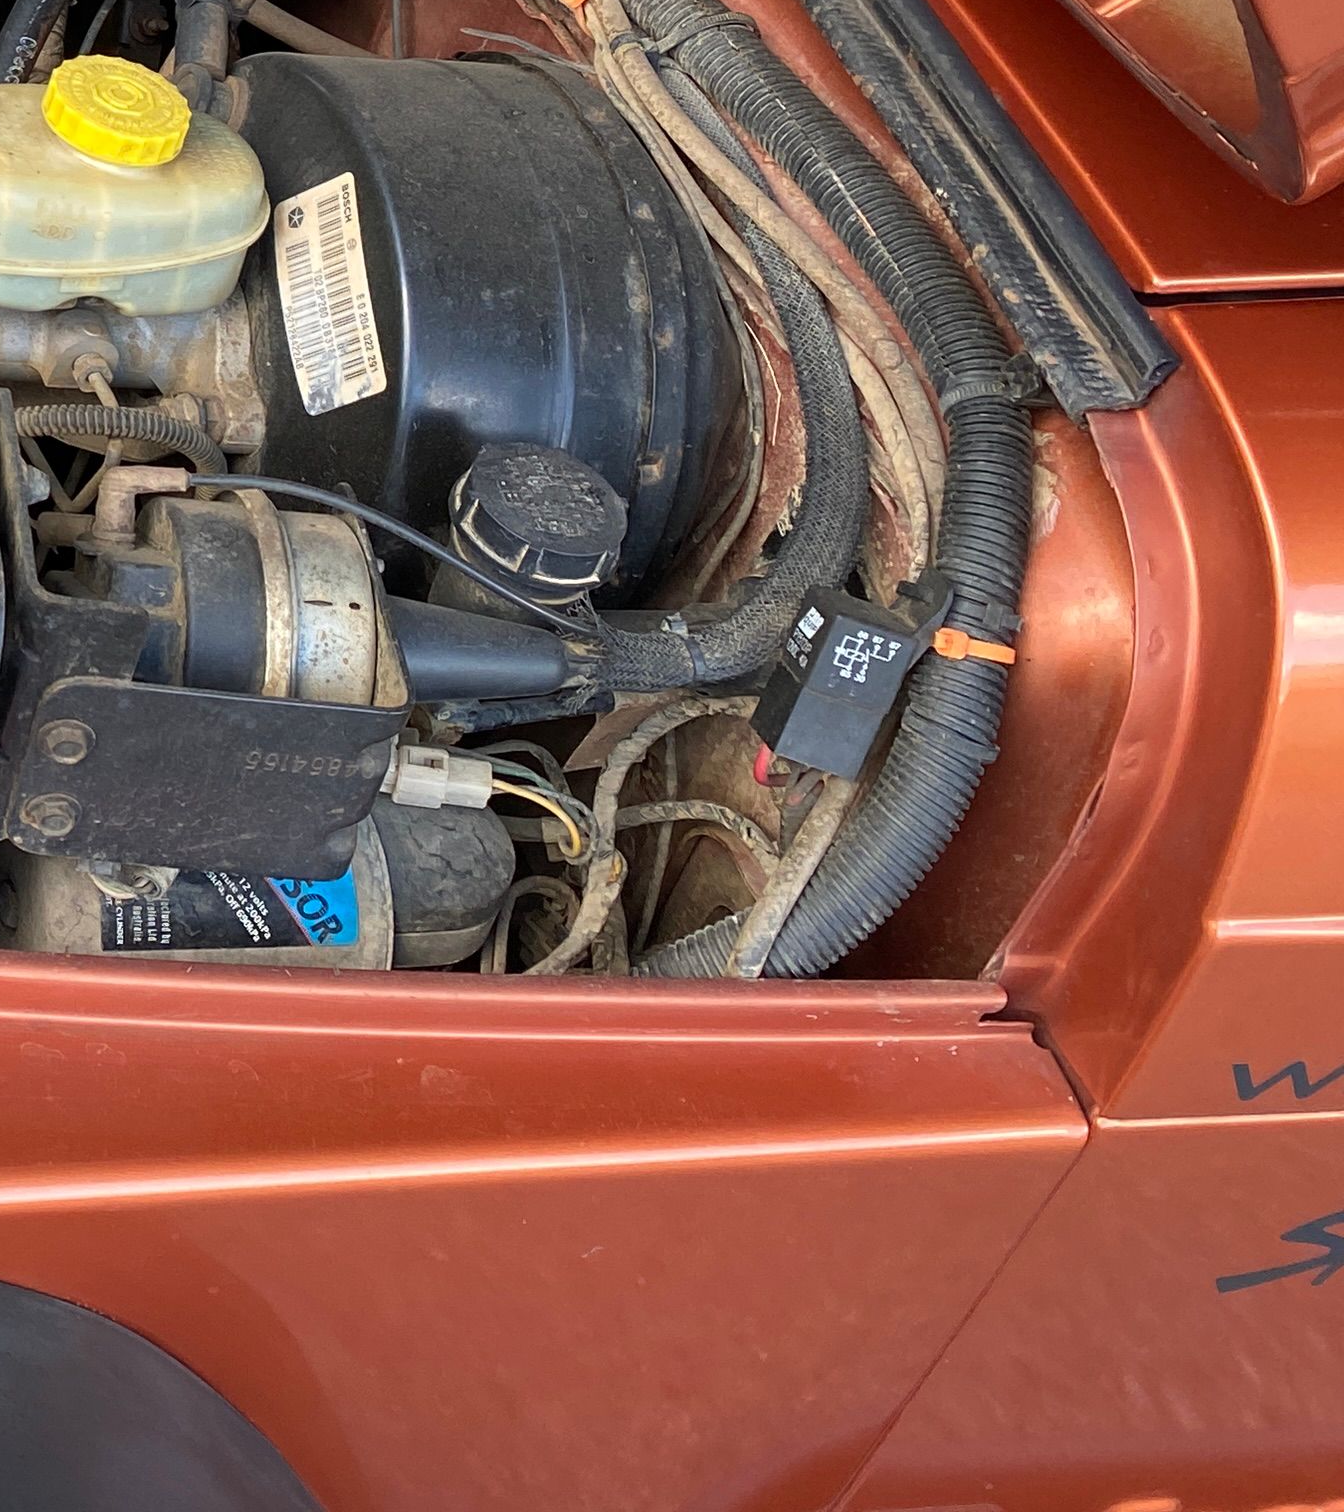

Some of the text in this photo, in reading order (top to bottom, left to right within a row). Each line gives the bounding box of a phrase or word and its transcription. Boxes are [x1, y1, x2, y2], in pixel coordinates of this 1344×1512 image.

[341, 183, 353, 224] BOSCH
[362, 332, 375, 354] 022
[219, 872, 272, 940] nute at 200kPa
[238, 877, 269, 917] 12 volts
[115, 906, 124, 945] CYLINDER
[225, 894, 240, 910] Off
[236, 908, 261, 943] 690kPa
[160, 933, 172, 945] by
